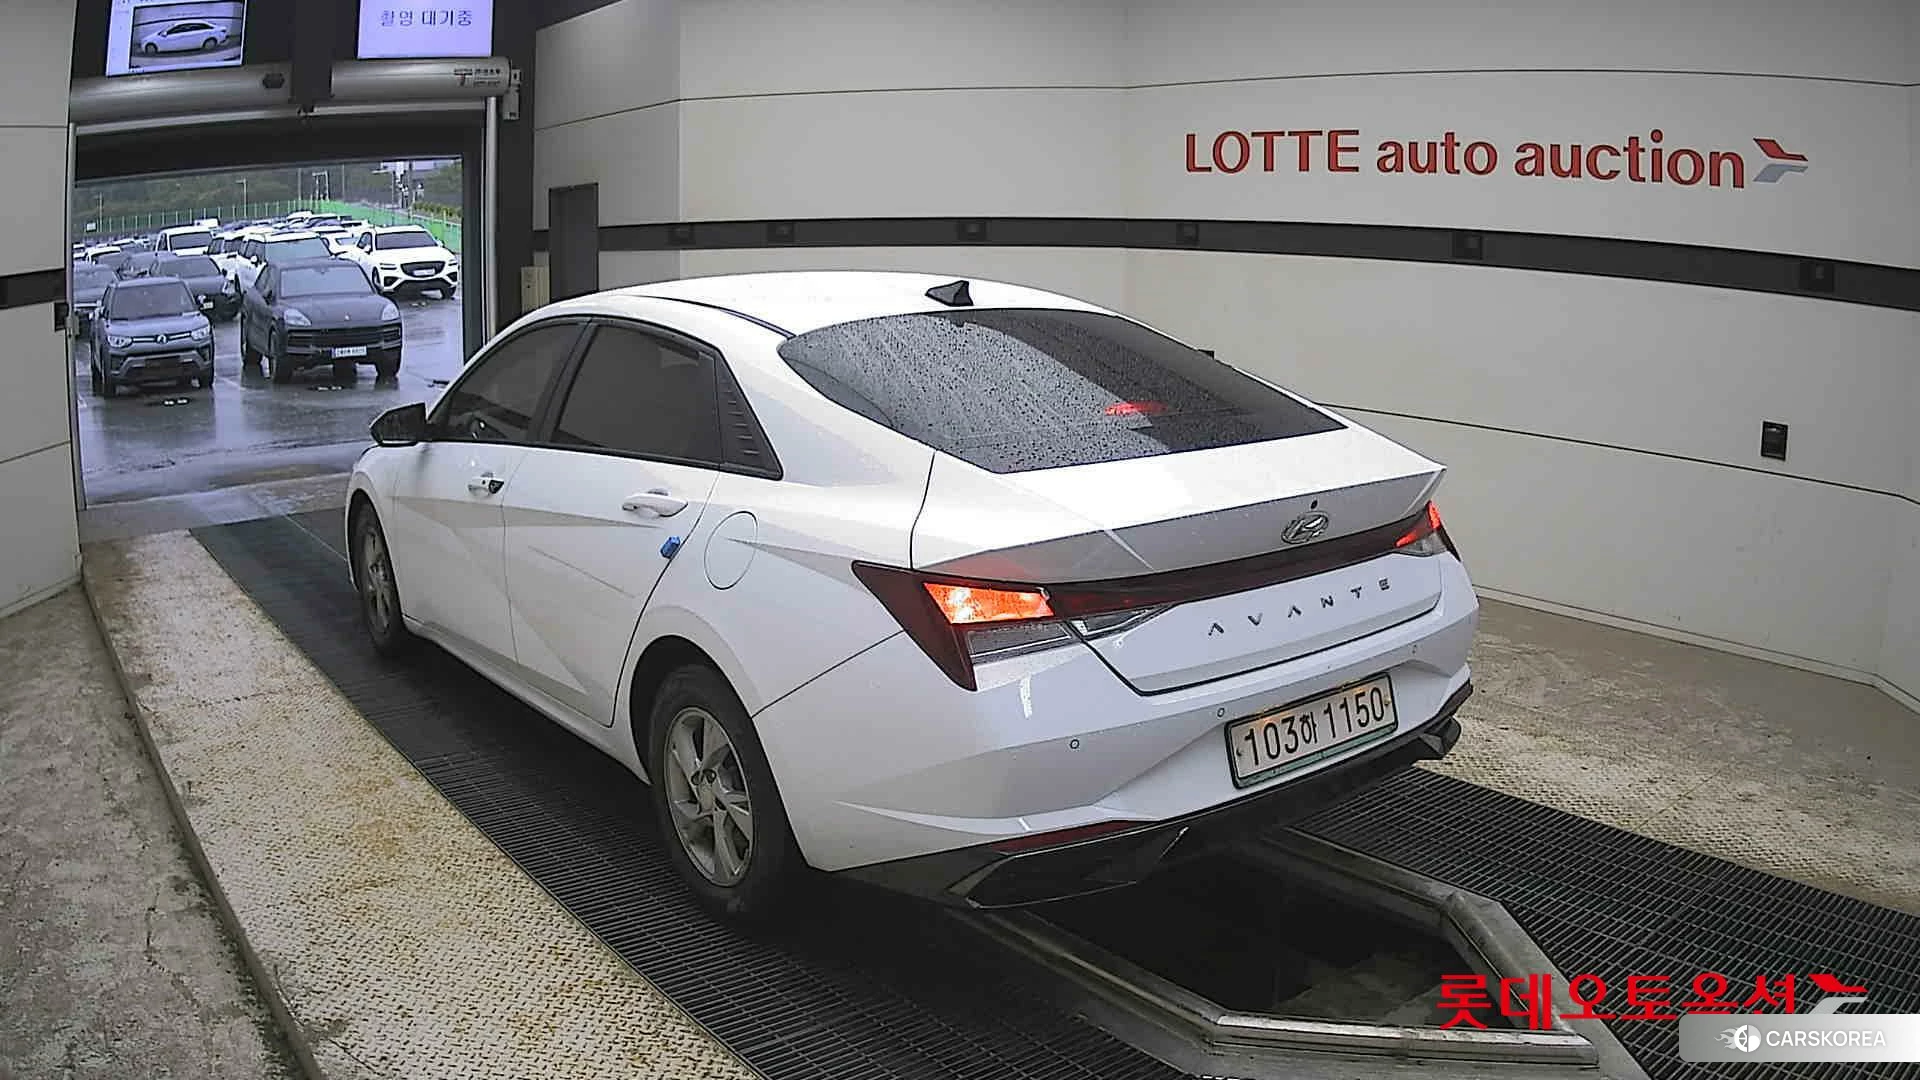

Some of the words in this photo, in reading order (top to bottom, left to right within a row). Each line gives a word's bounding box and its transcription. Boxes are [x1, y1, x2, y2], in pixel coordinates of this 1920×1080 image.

[422, 10, 472, 26] 대기중
[1185, 129, 1360, 173] LOTTE
[1376, 131, 1499, 176] auto
[1513, 128, 1746, 190] auction
[1207, 576, 1391, 637] AVANTE
[1243, 710, 1319, 767] 103하
[1323, 686, 1386, 739] 1150
